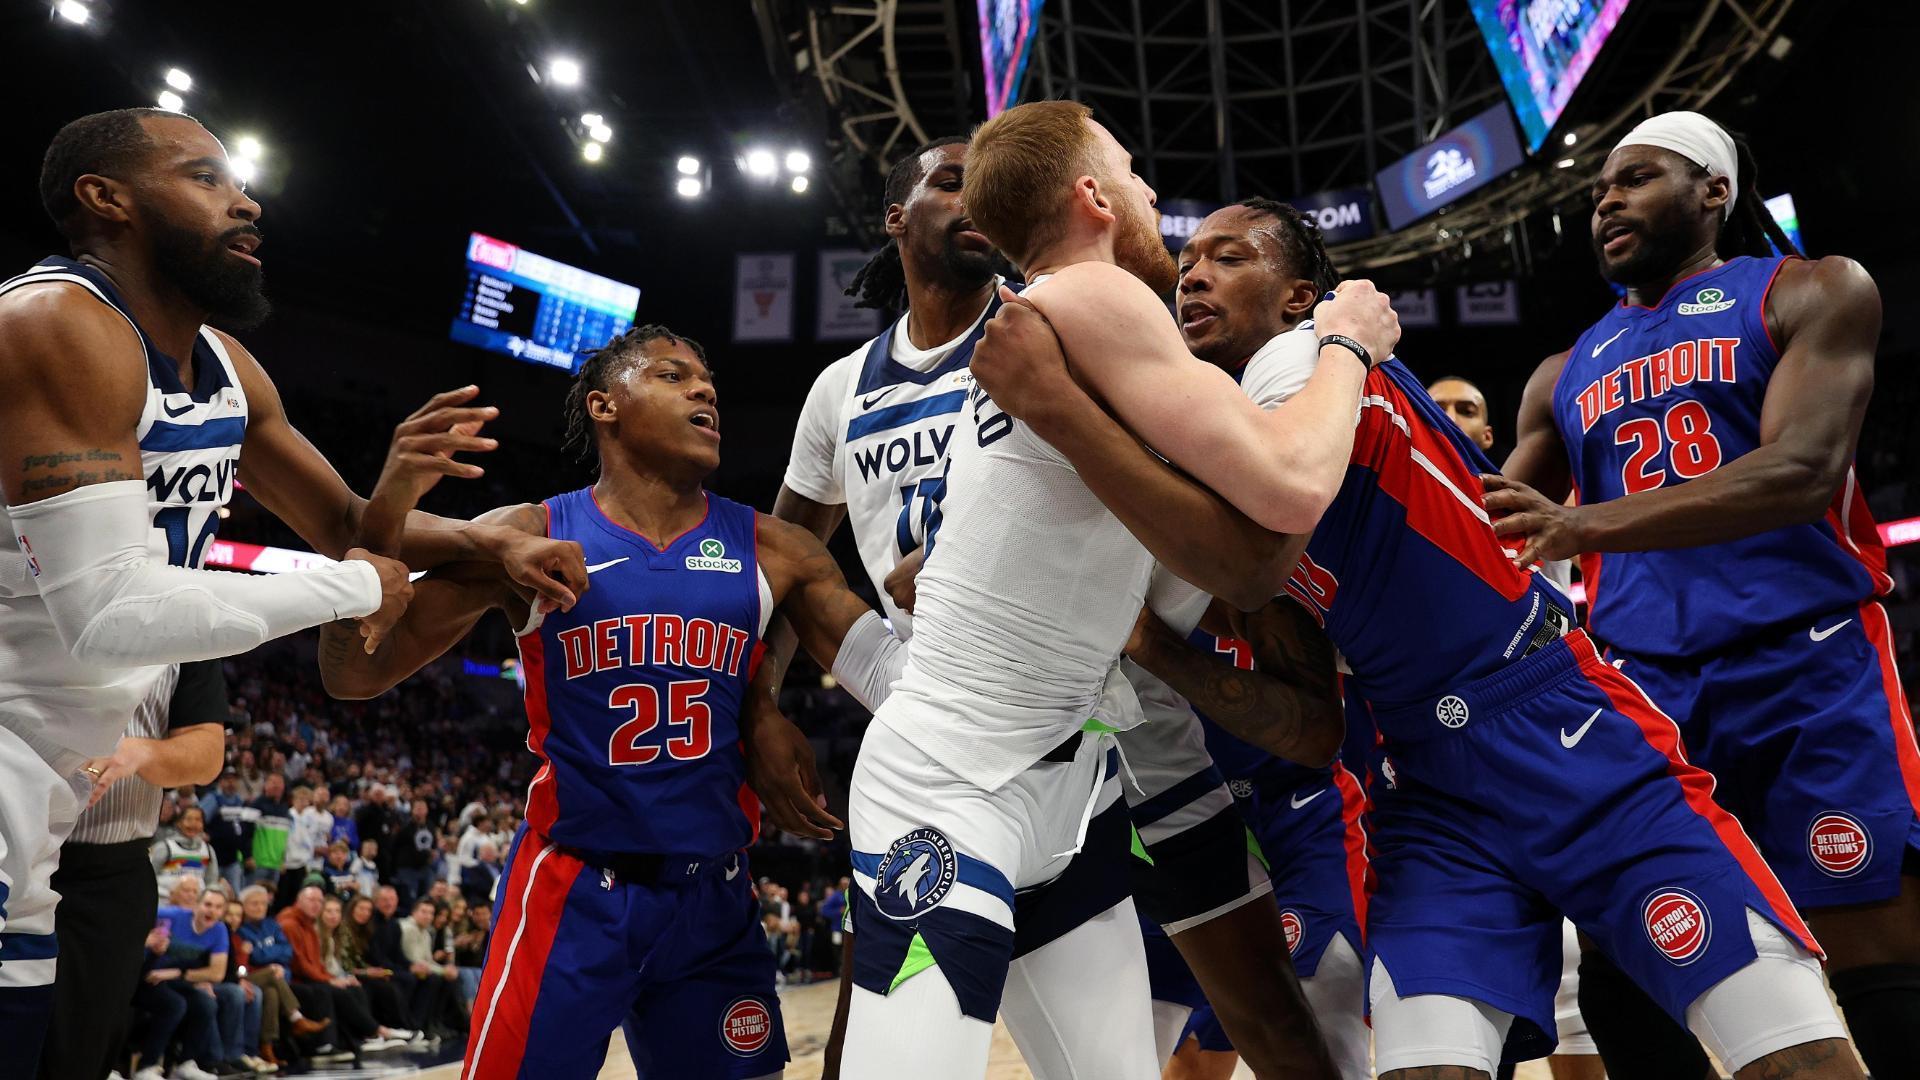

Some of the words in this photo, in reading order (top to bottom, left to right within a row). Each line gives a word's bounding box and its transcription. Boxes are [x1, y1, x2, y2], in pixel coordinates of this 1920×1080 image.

[1680, 301, 1735, 313] StockX
[1332, 335, 1365, 356] Blessed
[1575, 338, 1740, 435] DETROIT
[1614, 400, 1722, 496] 28
[687, 558, 740, 571] StockX
[1503, 629, 1524, 660] DETROIT
[1520, 591, 1540, 632] BASKETBALL
[557, 613, 749, 681] DETROIT
[608, 679, 712, 766] 25
[1816, 832, 1855, 845] DETROIT
[1817, 842, 1859, 856] PISTONS
[878, 833, 919, 887] MINNESOTA
[924, 830, 953, 905] TIMBERWOLVES
[1651, 904, 1690, 935] DETROIT
[1658, 914, 1697, 947] PISTONS
[730, 1013, 764, 1028] DETROIT
[731, 1023, 766, 1038] PISTONS
